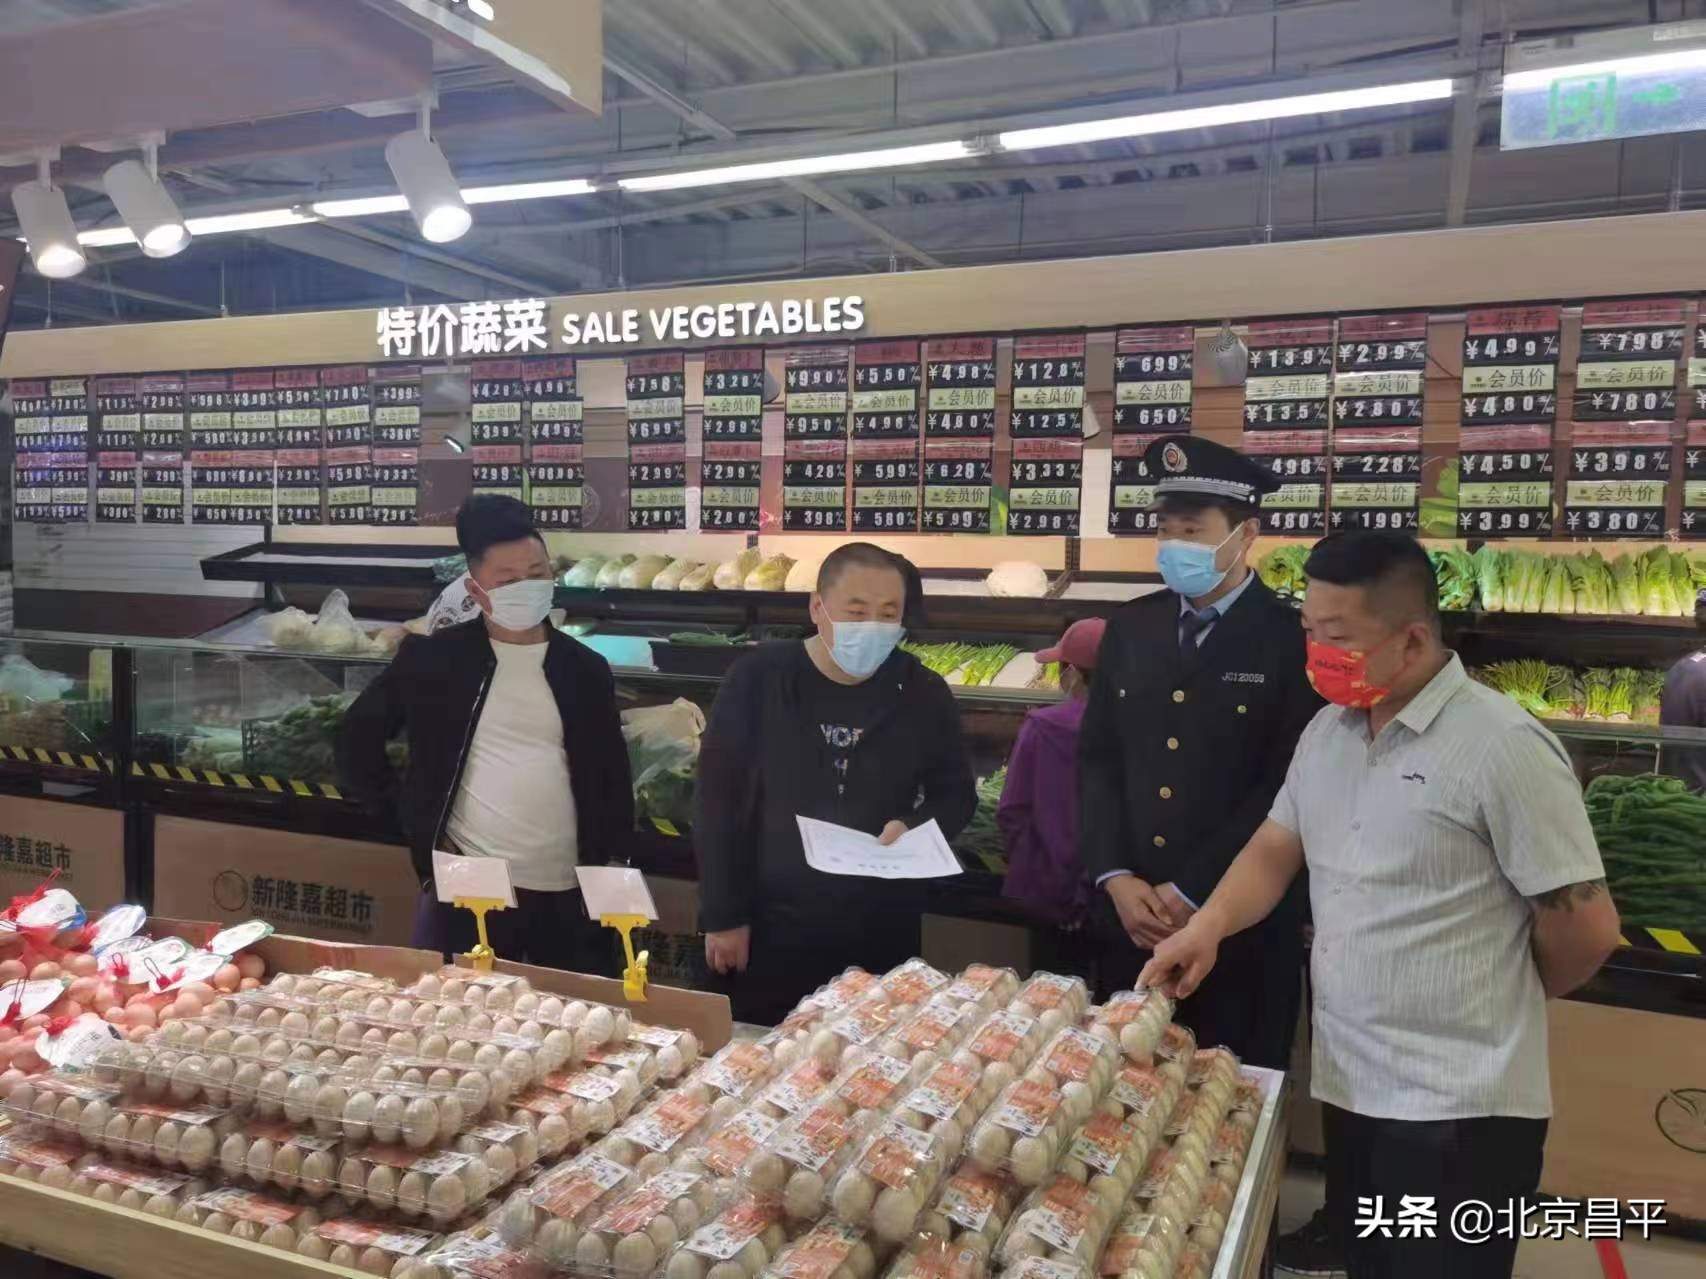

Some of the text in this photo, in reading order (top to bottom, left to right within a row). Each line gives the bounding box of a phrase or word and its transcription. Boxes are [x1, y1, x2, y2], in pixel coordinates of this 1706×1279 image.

[376, 295, 865, 357] 特价蔬菜 SALE VEGETABLES
[1359, 376, 1410, 392] 会员价
[1488, 368, 1547, 388] 会员价
[1605, 366, 1668, 384] 会员价
[871, 393, 910, 408] 会员价
[950, 390, 990, 406] 会员价
[1034, 388, 1077, 406] 会员价
[1138, 384, 1184, 401] 会员价
[801, 490, 838, 504] 会员价
[874, 490, 912, 505] 会员价
[944, 486, 985, 504] 会员价
[1031, 488, 1073, 506] 会员价
[1356, 486, 1408, 502] 会员价
[1486, 484, 1542, 505] 会员价
[1595, 484, 1656, 502] 会员价
[252, 875, 374, 922] 新隆嘉超市
